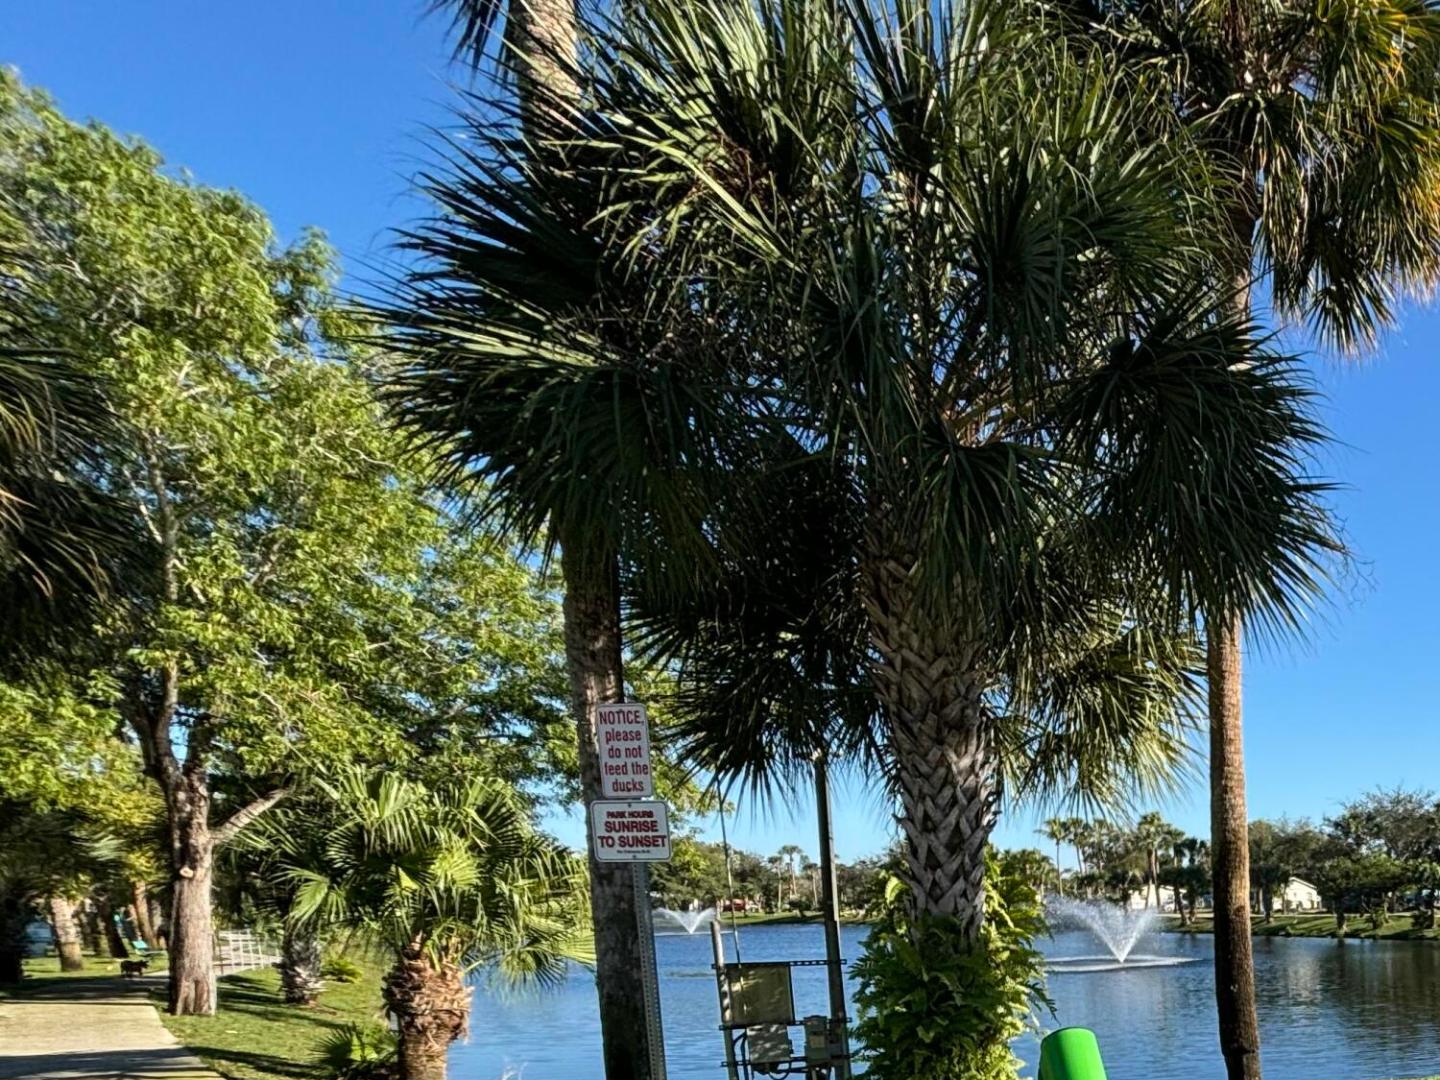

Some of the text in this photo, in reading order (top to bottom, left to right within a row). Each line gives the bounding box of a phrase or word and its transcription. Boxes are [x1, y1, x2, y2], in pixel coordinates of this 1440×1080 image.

[605, 728, 641, 745] please
[608, 745, 642, 758] do not
[604, 761, 648, 775] feed the
[612, 778, 644, 792] ducks
[628, 810, 653, 818] HOURS
[605, 821, 659, 833] SUNRISE
[598, 835, 666, 848] TO SUNSET
